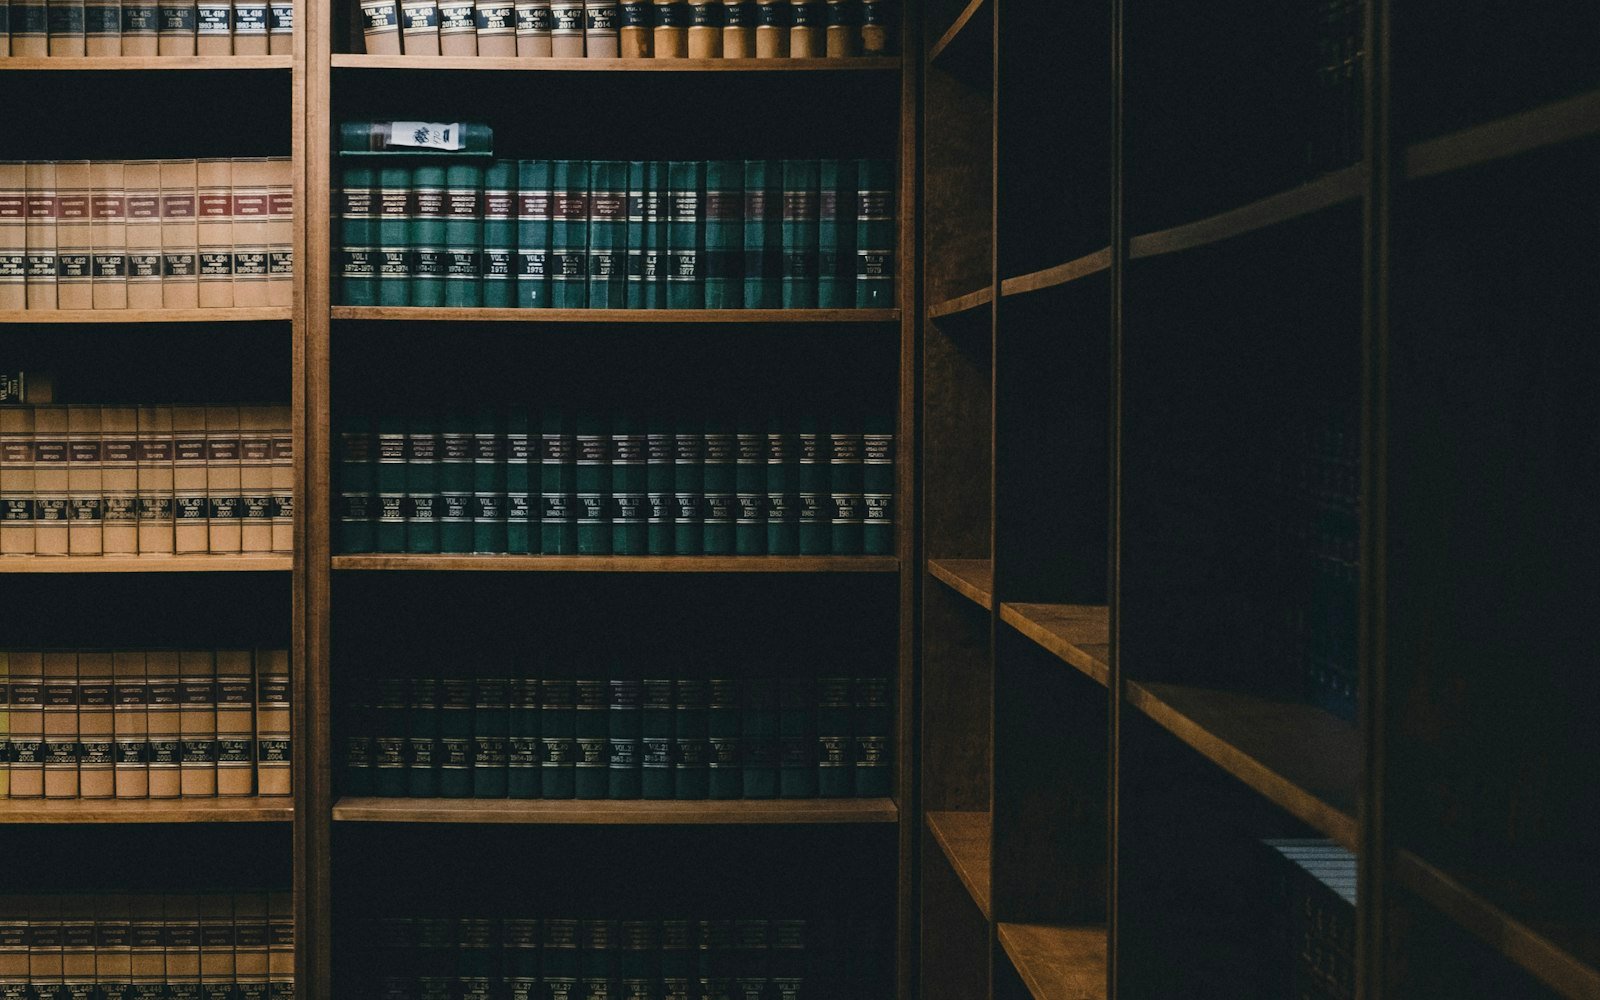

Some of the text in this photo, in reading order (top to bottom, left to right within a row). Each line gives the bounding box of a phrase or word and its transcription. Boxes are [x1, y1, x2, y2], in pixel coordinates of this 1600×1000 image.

[412, 19, 428, 27] 2012
[488, 20, 505, 28] 2013
[559, 21, 576, 29] 2014
[594, 21, 610, 29] 2014
